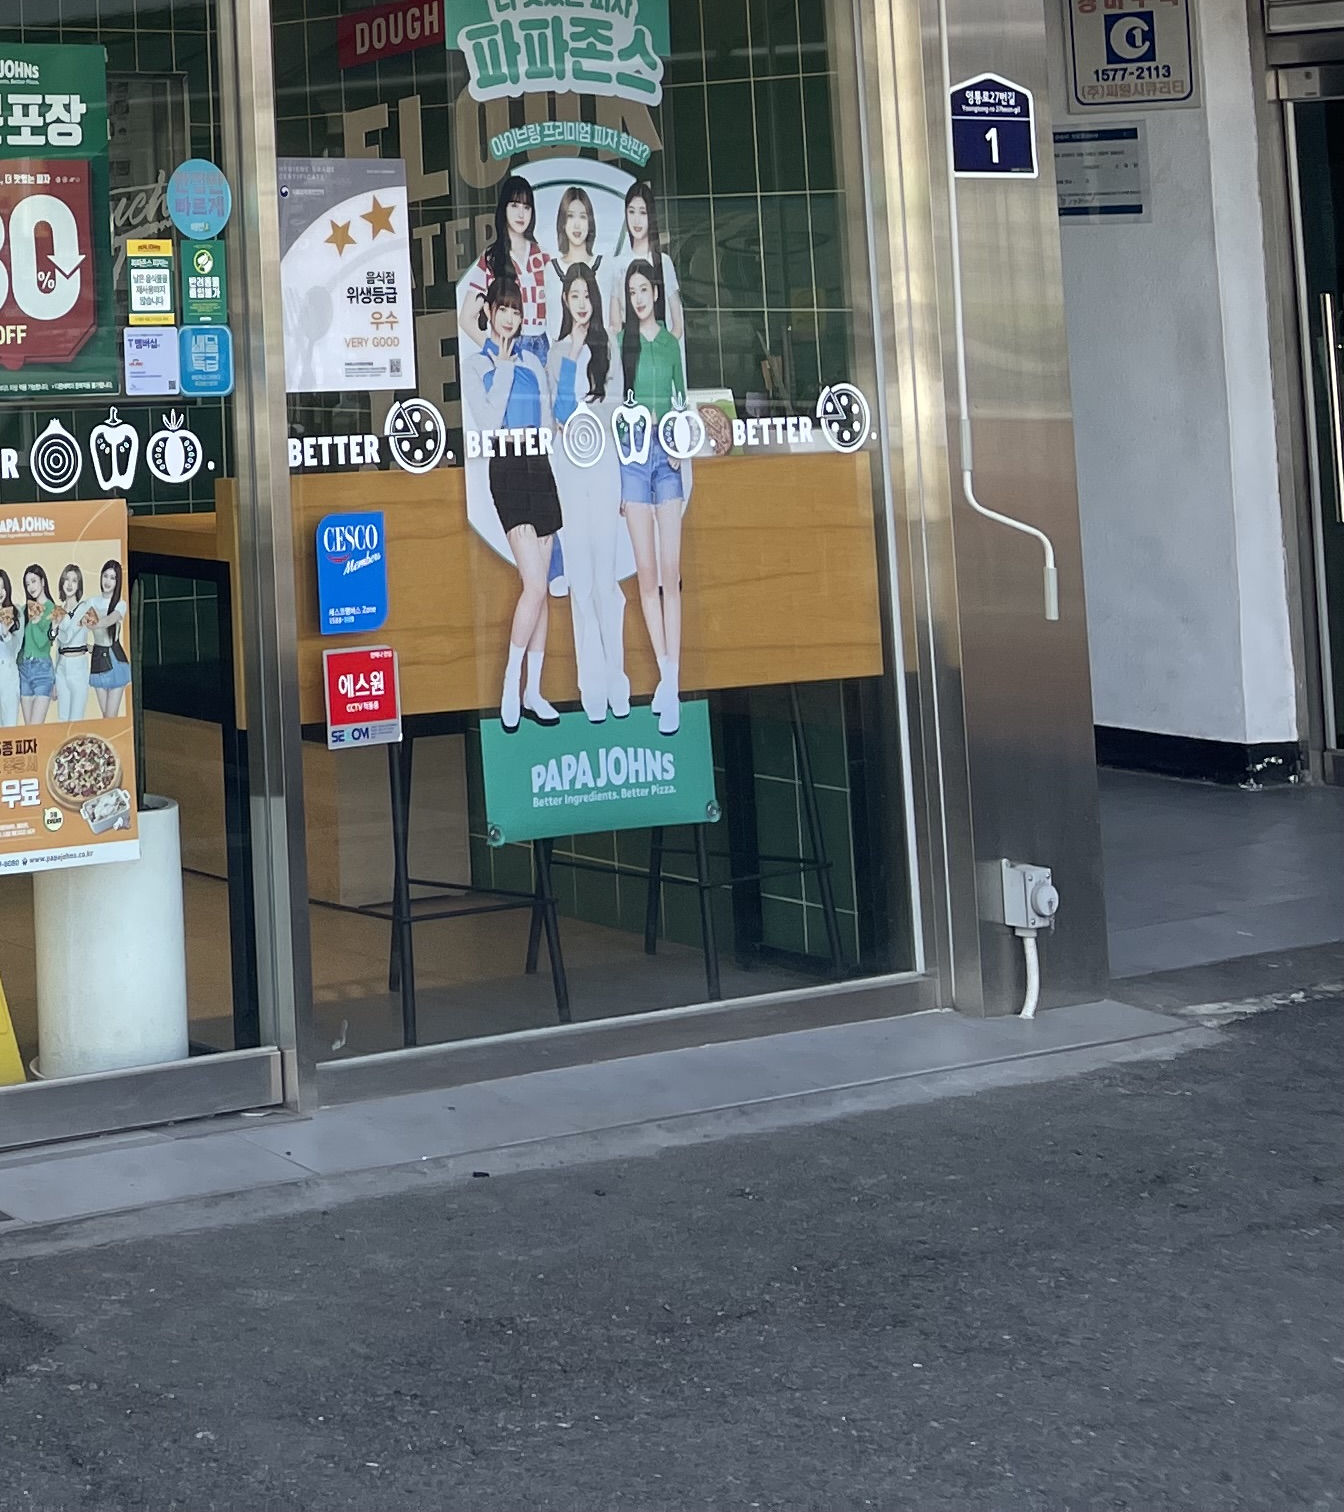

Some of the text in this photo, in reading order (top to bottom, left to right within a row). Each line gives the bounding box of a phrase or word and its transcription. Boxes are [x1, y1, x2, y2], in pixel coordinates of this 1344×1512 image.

[354, 0, 440, 56] DOUGH
[462, 14, 659, 95] 파파존스
[1093, 64, 1172, 83] 1577-2113
[543, 120, 592, 143] 프리미엄
[592, 124, 618, 148] 피자
[984, 127, 1000, 164] 1
[365, 271, 396, 285] 음식점
[346, 286, 398, 305] 위생등급
[370, 310, 400, 331] 우수
[344, 336, 400, 348] VERY GOOD
[466, 425, 554, 459] BETTER
[732, 415, 814, 447] BETTER
[286, 432, 381, 468] BETTER
[19, 516, 55, 534] JOHNS
[323, 524, 379, 553] CESCO
[342, 551, 382, 576] Members
[338, 670, 386, 699] 에스원
[345, 702, 364, 714] CCTV
[15, 738, 38, 755] 피자
[530, 745, 676, 794] PAPA JOHNS
[1, 777, 42, 809] 무료
[532, 783, 677, 808] Better Ingredients. Better Pizza.
